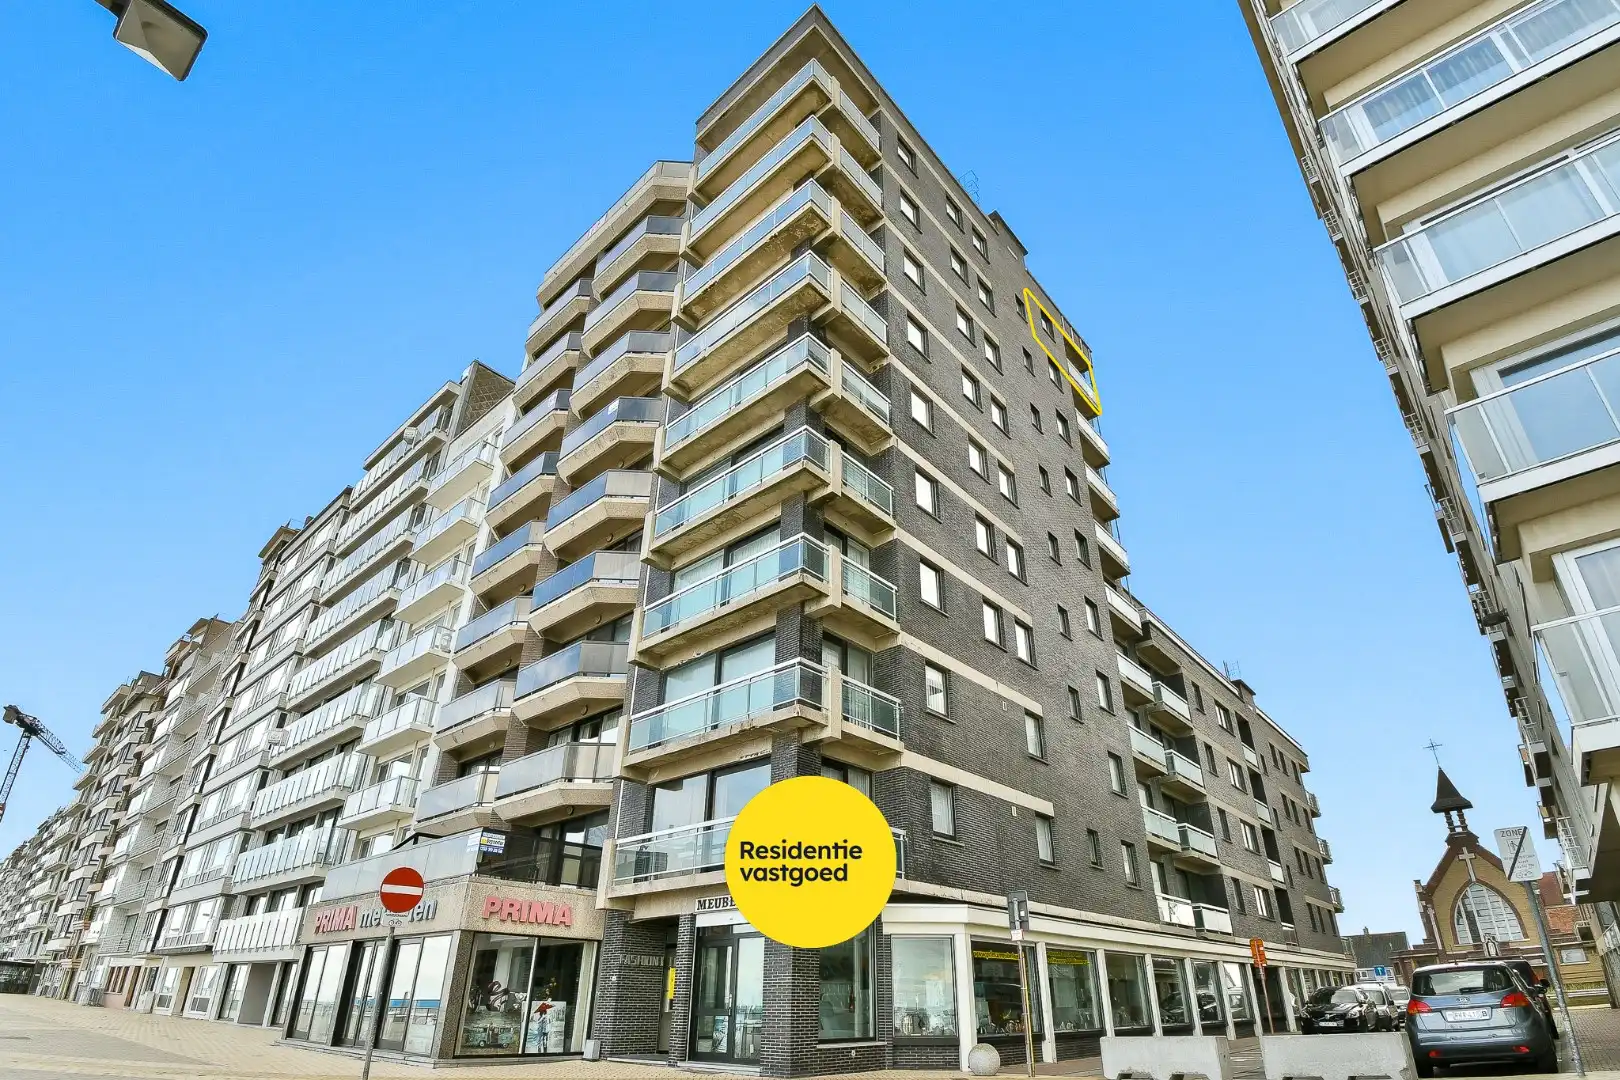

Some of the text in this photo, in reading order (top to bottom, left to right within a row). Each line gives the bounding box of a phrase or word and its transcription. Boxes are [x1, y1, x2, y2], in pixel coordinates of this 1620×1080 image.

[1500, 829, 1524, 837] ZONE
[314, 905, 357, 934] PRIMA
[482, 895, 573, 926] PRIMA
